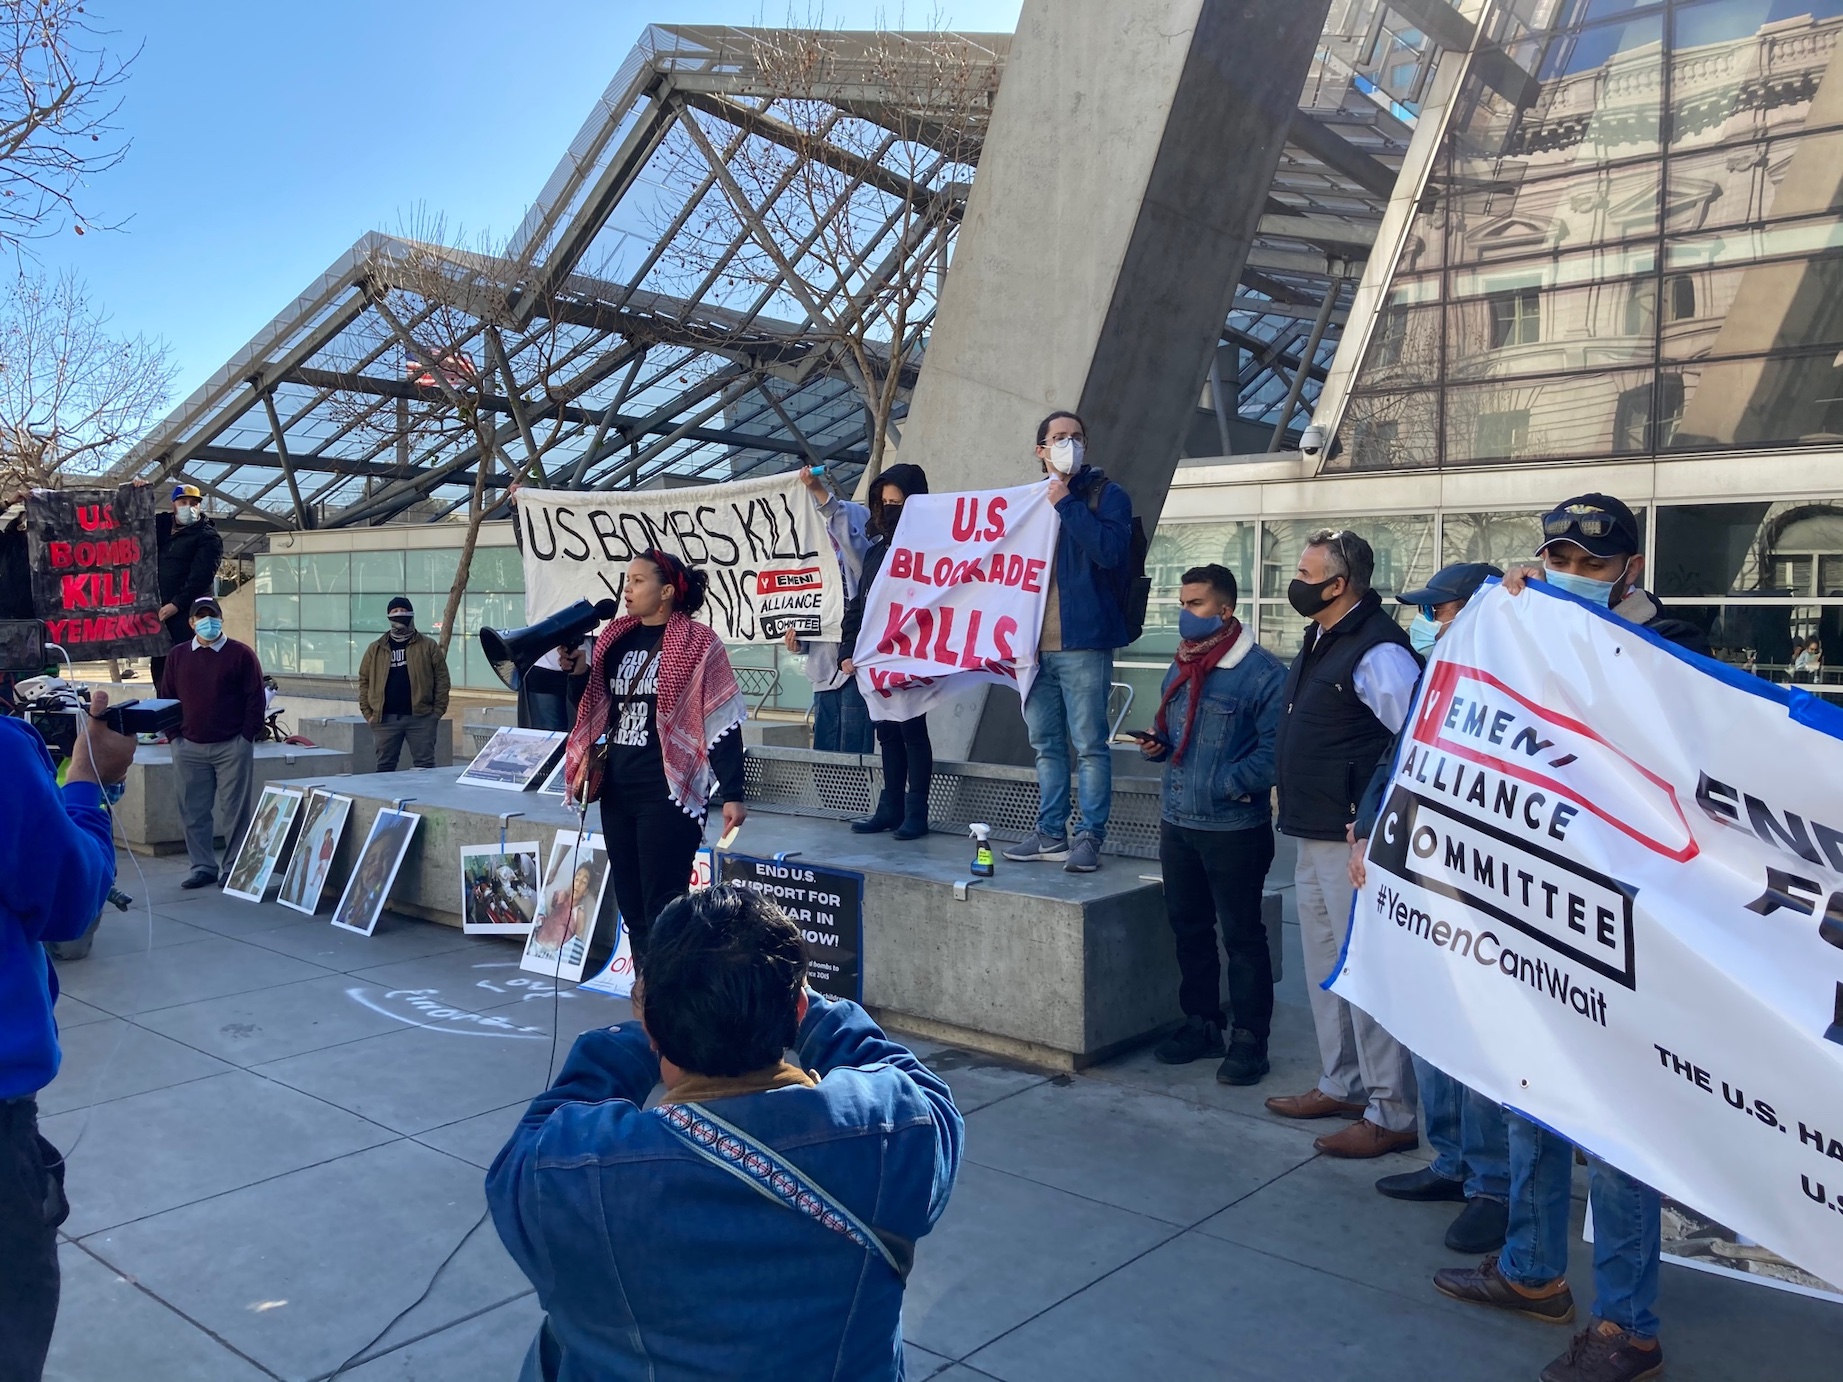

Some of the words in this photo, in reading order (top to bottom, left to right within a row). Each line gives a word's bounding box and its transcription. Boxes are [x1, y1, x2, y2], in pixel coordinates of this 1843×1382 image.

[588, 505, 740, 566] BOMBS
[731, 493, 819, 563] KILL
[952, 496, 1008, 542] U.S.
[49, 536, 141, 568] BOMBS
[889, 547, 1047, 594] BLOCKADE
[60, 570, 137, 609] KILL
[761, 573, 814, 589] YEMENI
[597, 568, 758, 640] YNIS
[760, 593, 822, 614] ALLIANCE
[45, 611, 161, 644] YEMENIS
[876, 601, 1019, 670] KILLS
[622, 650, 662, 666] CLOE
[610, 677, 659, 696] PRIONS
[1422, 689, 1578, 768] YEMENI
[1401, 745, 1579, 842] ALLIANCE
[755, 863, 789, 879] END
[791, 868, 817, 883] U.S.
[1383, 811, 1616, 949] COMMITTEE
[808, 890, 841, 908] FOR
[816, 911, 834, 926] IN
[813, 960, 832, 971] bombs
[1376, 884, 1608, 1028] #YemenCantWait
[1653, 1042, 1713, 1094] THE
[1721, 1080, 1787, 1134] U.S.
